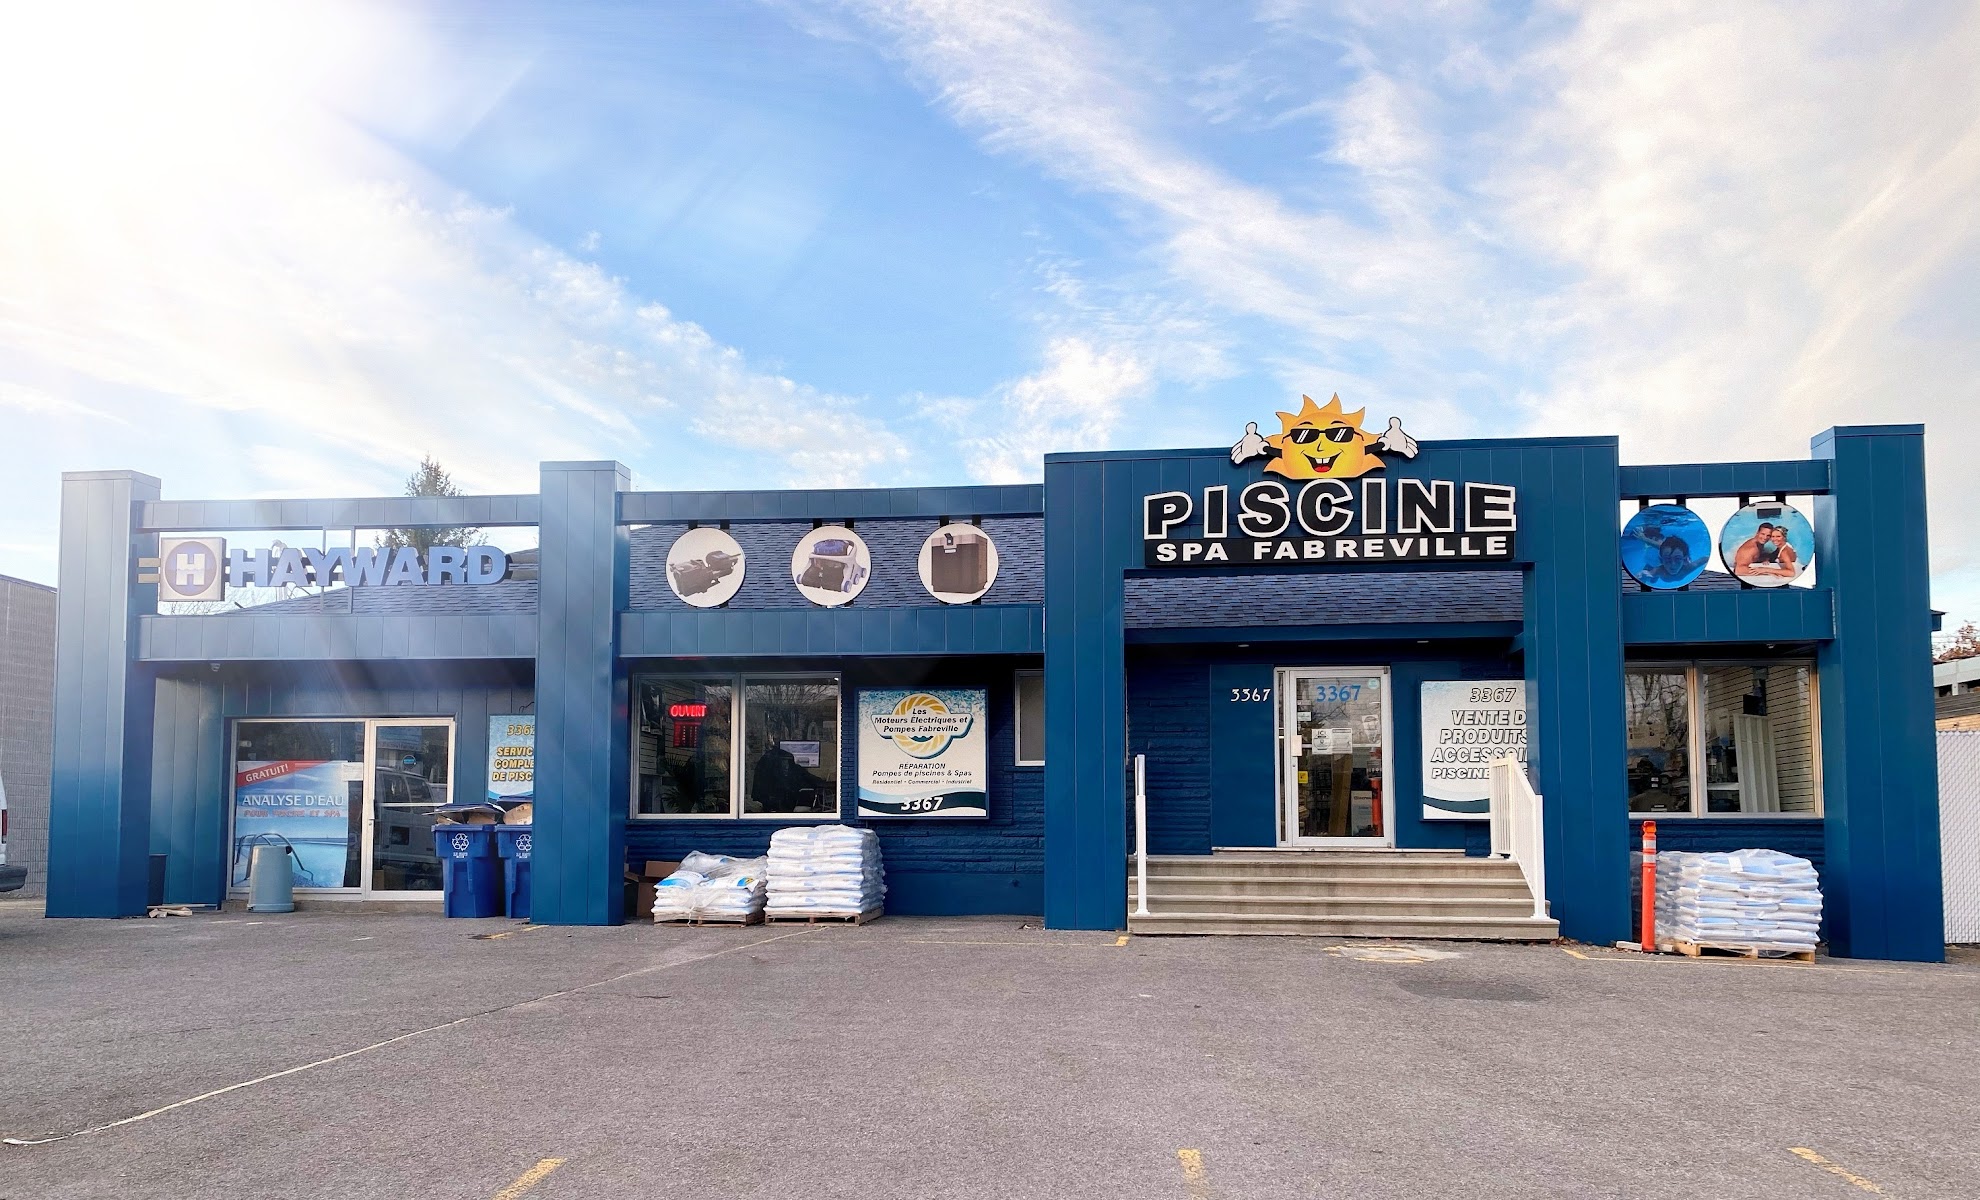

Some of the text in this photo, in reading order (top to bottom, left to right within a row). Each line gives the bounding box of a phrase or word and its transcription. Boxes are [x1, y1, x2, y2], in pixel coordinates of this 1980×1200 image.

[1144, 478, 1517, 539] PISCINE
[1156, 536, 1508, 562] SPA FABREVILLE
[176, 545, 506, 587] H HAYWARD
[1230, 688, 1271, 702] 3367
[1316, 685, 1362, 702] 3367
[1470, 688, 1517, 702] 3367
[670, 705, 707, 717] OUVERT
[1451, 709, 1510, 726] VENTE
[883, 725, 916, 733] Pompes
[245, 763, 289, 783] GRATUIT!
[898, 762, 946, 770] RÉPARATION
[492, 771, 506, 782] DE
[241, 795, 344, 806] ANALYSE D'EAU
[900, 797, 944, 811] 3367
[324, 809, 341, 818] SPA
